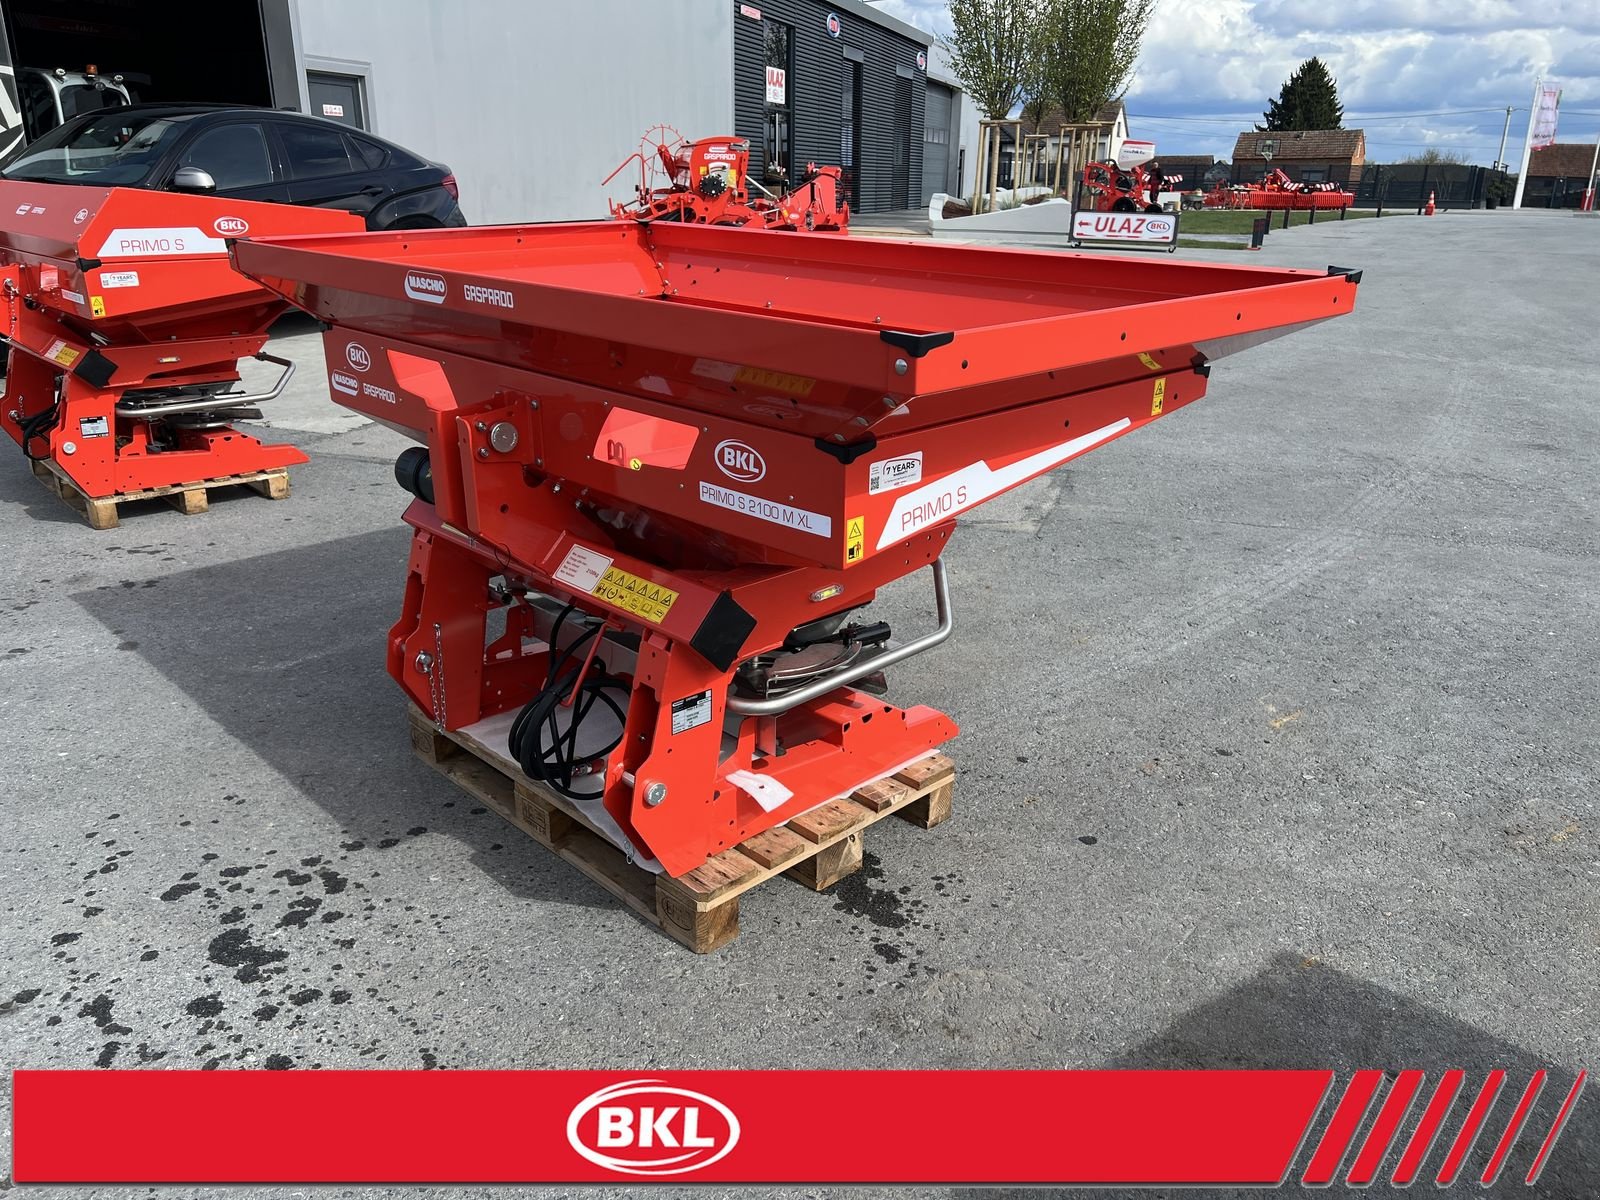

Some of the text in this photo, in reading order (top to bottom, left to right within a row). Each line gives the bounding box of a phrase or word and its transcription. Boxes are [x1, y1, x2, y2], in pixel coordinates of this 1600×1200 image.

[767, 69, 784, 88] ULAZ
[220, 220, 245, 230] BKL
[1094, 216, 1147, 234] ULAZ
[120, 239, 185, 252] PRIMO S
[408, 275, 514, 308] MASCHIO GASPARDO
[349, 347, 368, 365] BKL
[334, 372, 396, 404] MASCHIO GASPARDO
[723, 446, 760, 474] BKL
[886, 467, 891, 475] 7
[892, 460, 915, 474] YEARS
[701, 485, 813, 529] PRIMO S 2100 M XL
[901, 485, 967, 531] PRIMO S
